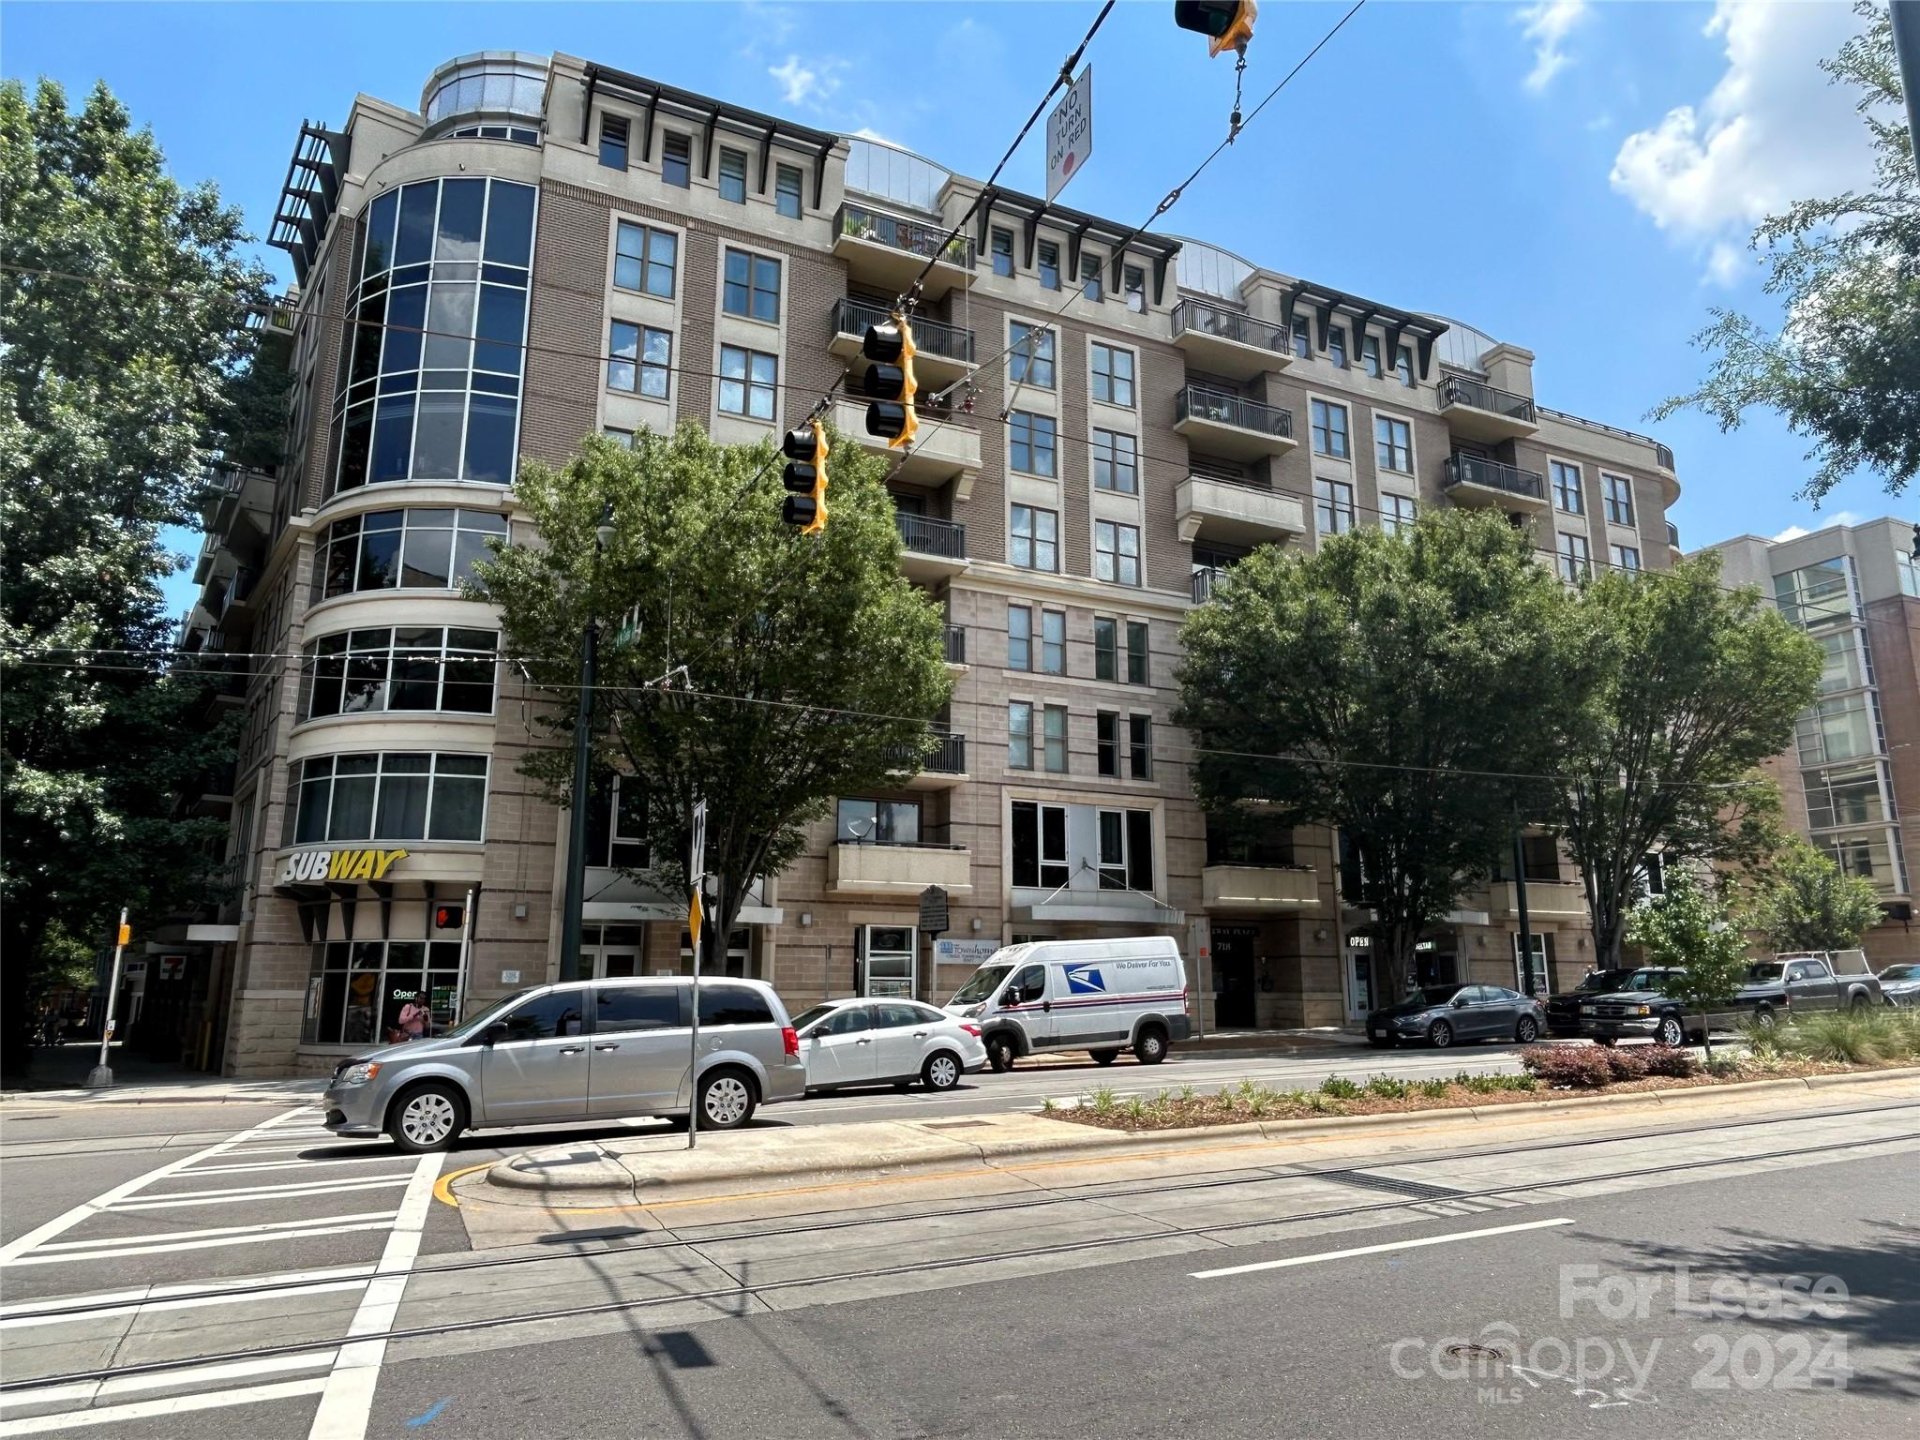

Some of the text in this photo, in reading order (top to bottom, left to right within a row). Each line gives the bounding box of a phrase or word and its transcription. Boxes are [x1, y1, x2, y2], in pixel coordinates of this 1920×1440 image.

[1055, 103, 1083, 146] TURN
[1058, 90, 1078, 125] NO
[1050, 117, 1087, 170] ON RED
[281, 848, 409, 884] SUBWAY
[1350, 936, 1369, 947] OPEN
[1127, 961, 1148, 969] Deliver
[1148, 960, 1159, 968] For
